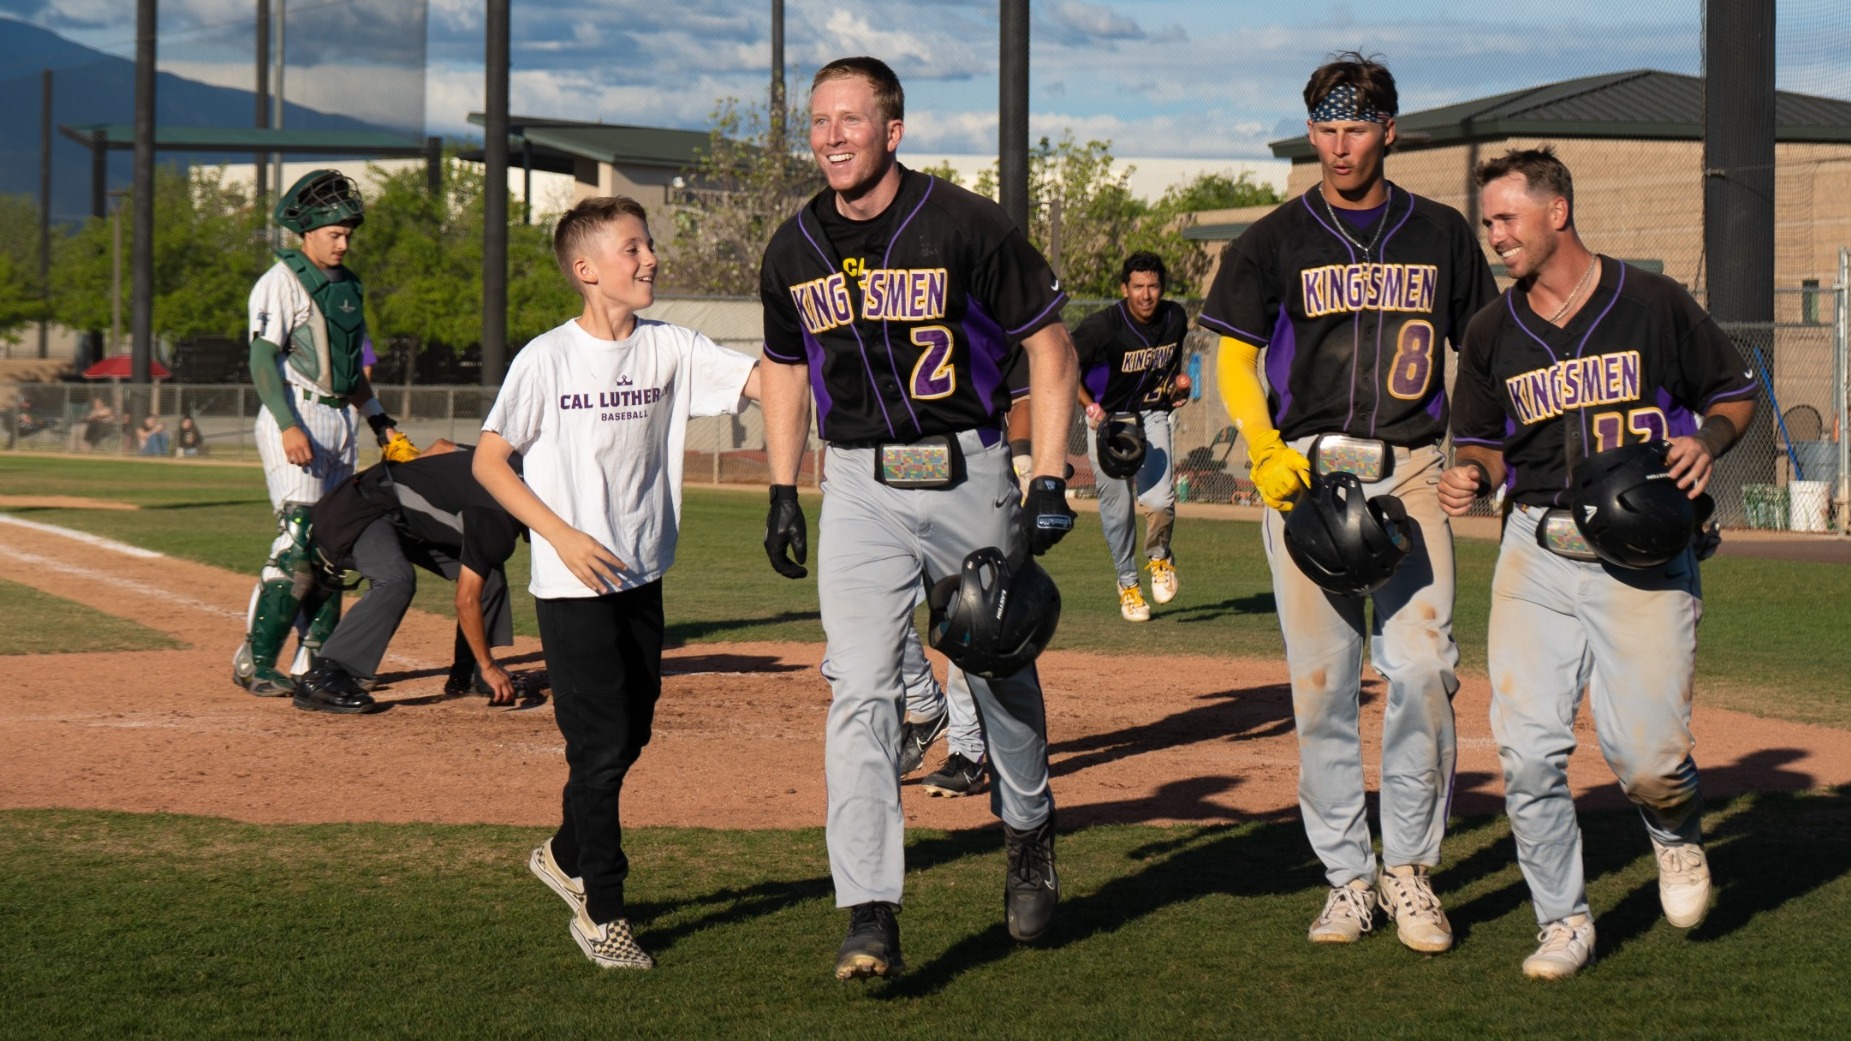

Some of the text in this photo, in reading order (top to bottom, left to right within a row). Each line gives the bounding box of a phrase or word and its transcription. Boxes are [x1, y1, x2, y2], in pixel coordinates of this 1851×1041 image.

[1301, 262, 1438, 317] KINGSMEN
[909, 325, 956, 400] 2
[1387, 319, 1435, 400] 8
[1505, 350, 1641, 425] KINGSMEN
[560, 393, 594, 410] CAL
[601, 410, 649, 421] BASEBALL
